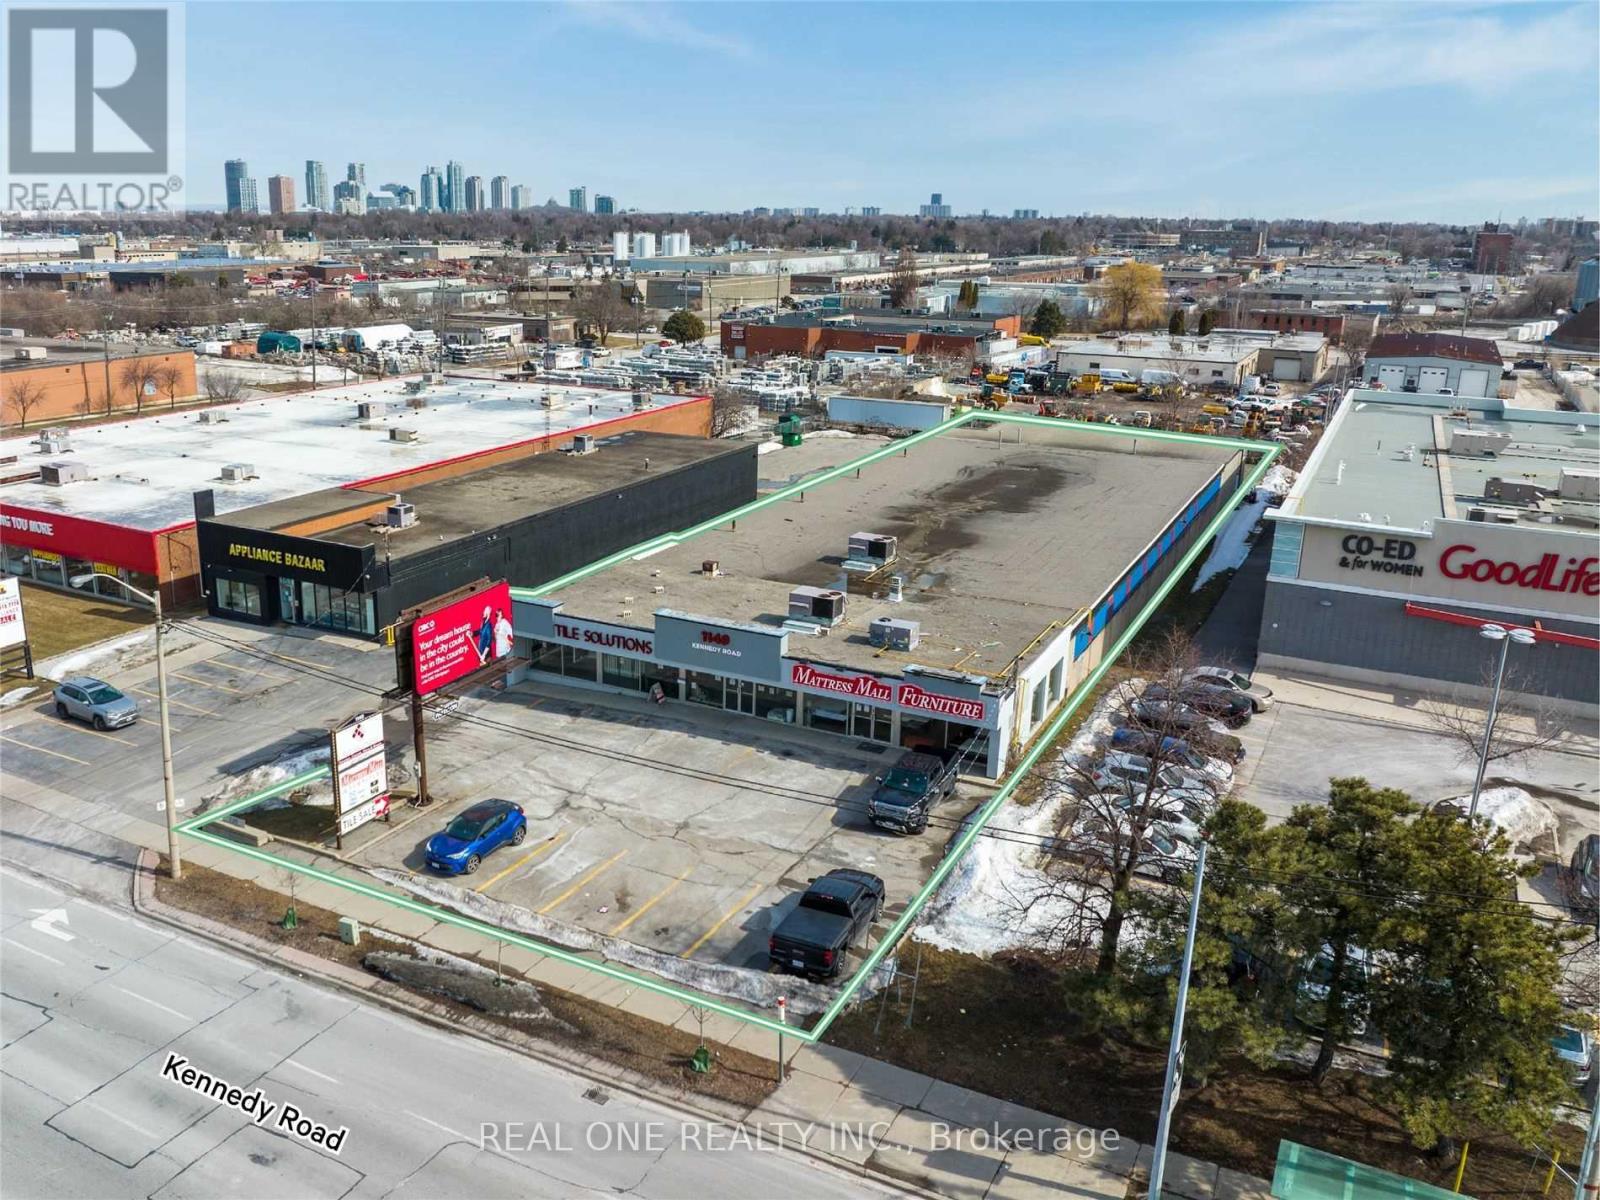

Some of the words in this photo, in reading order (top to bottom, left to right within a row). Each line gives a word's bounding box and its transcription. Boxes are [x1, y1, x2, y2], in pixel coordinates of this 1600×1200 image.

[11, 516, 28, 531] YOU
[29, 520, 54, 536] MORE
[229, 543, 282, 564] APPLIANCE
[284, 553, 326, 572] BAZAAR
[1341, 534, 1417, 560] CO-ED
[1338, 557, 1350, 568] &
[1351, 556, 1369, 571] for
[1370, 560, 1423, 577] WOMEN
[1440, 544, 1600, 596] GoodLife
[419, 639, 433, 651] Your
[433, 630, 453, 644] dream
[453, 623, 472, 635] house
[419, 653, 426, 662] in
[426, 649, 437, 659] the
[437, 643, 448, 653] city
[449, 633, 465, 648] could
[554, 623, 579, 641] TILE
[584, 629, 653, 655] SOLUTIONS
[691, 642, 721, 653] KENNEDY
[722, 648, 742, 657] ROAD
[420, 664, 428, 672] be
[429, 660, 435, 668] in
[435, 655, 446, 665] the
[901, 687, 982, 719] FURNITURE
[343, 815, 357, 829] TILE
[359, 805, 376, 820] SALE
